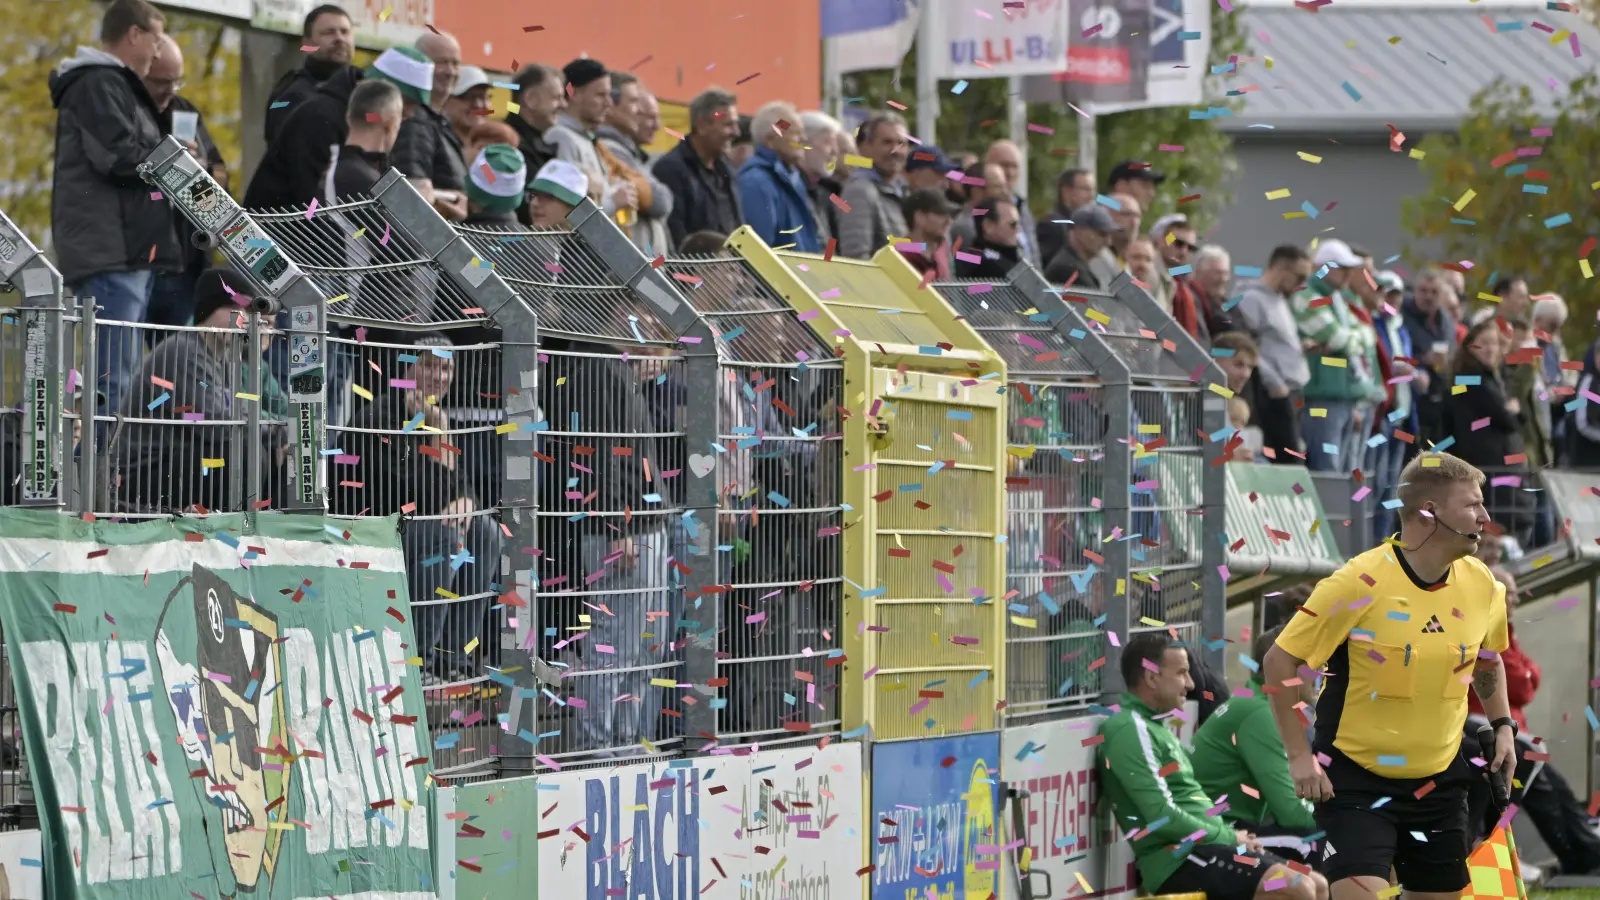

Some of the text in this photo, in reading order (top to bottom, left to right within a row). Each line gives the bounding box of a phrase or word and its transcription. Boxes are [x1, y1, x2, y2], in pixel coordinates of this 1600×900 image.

[951, 35, 1051, 64] ULLI-B
[36, 379, 46, 432] REZAT
[36, 440, 46, 492] BANDE
[303, 456, 313, 503] BANDE
[585, 767, 699, 900] BLACH
